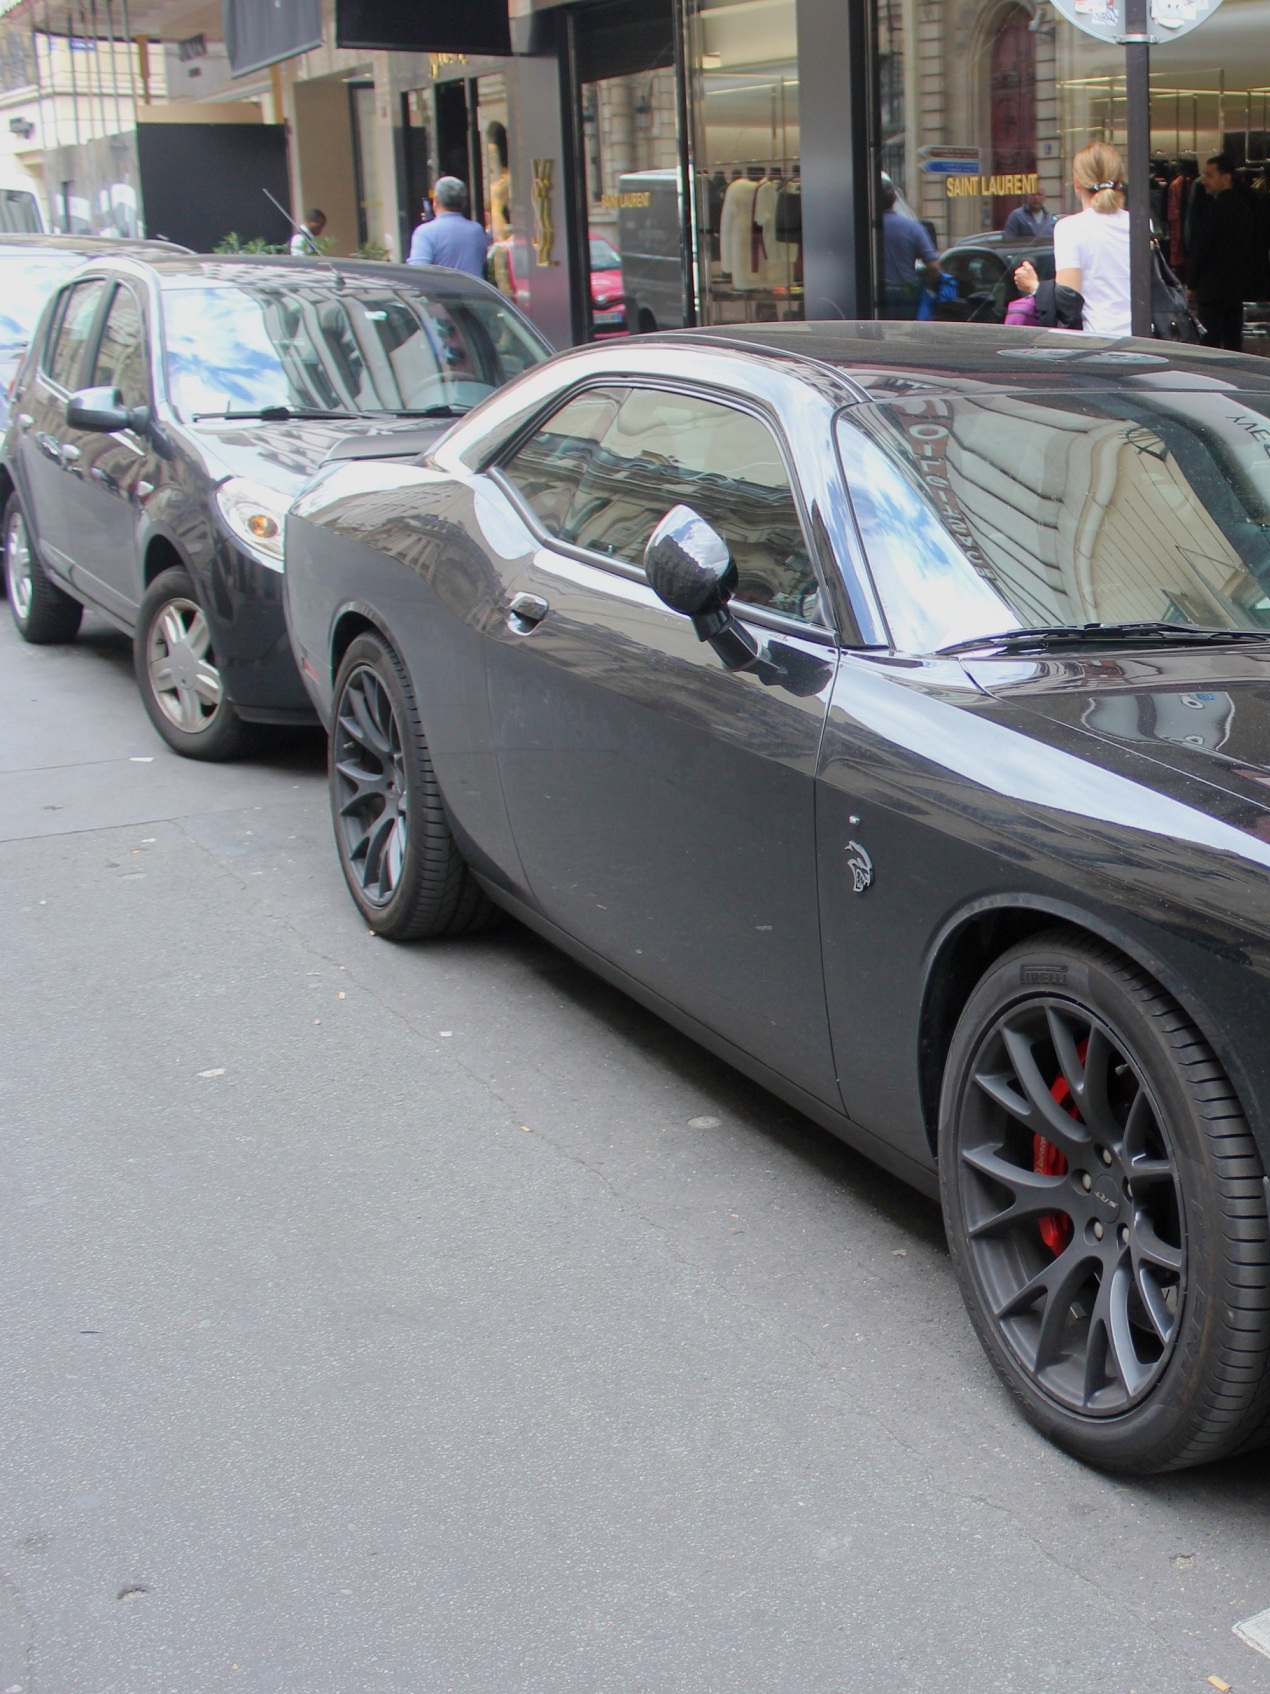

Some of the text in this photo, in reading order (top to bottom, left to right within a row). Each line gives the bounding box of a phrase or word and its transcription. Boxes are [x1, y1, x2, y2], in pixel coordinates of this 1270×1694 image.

[946, 174, 1038, 197] SAINT LAURENT
[601, 191, 650, 209] SAINT LAURENT
[1020, 964, 1069, 985] PIRELLI
